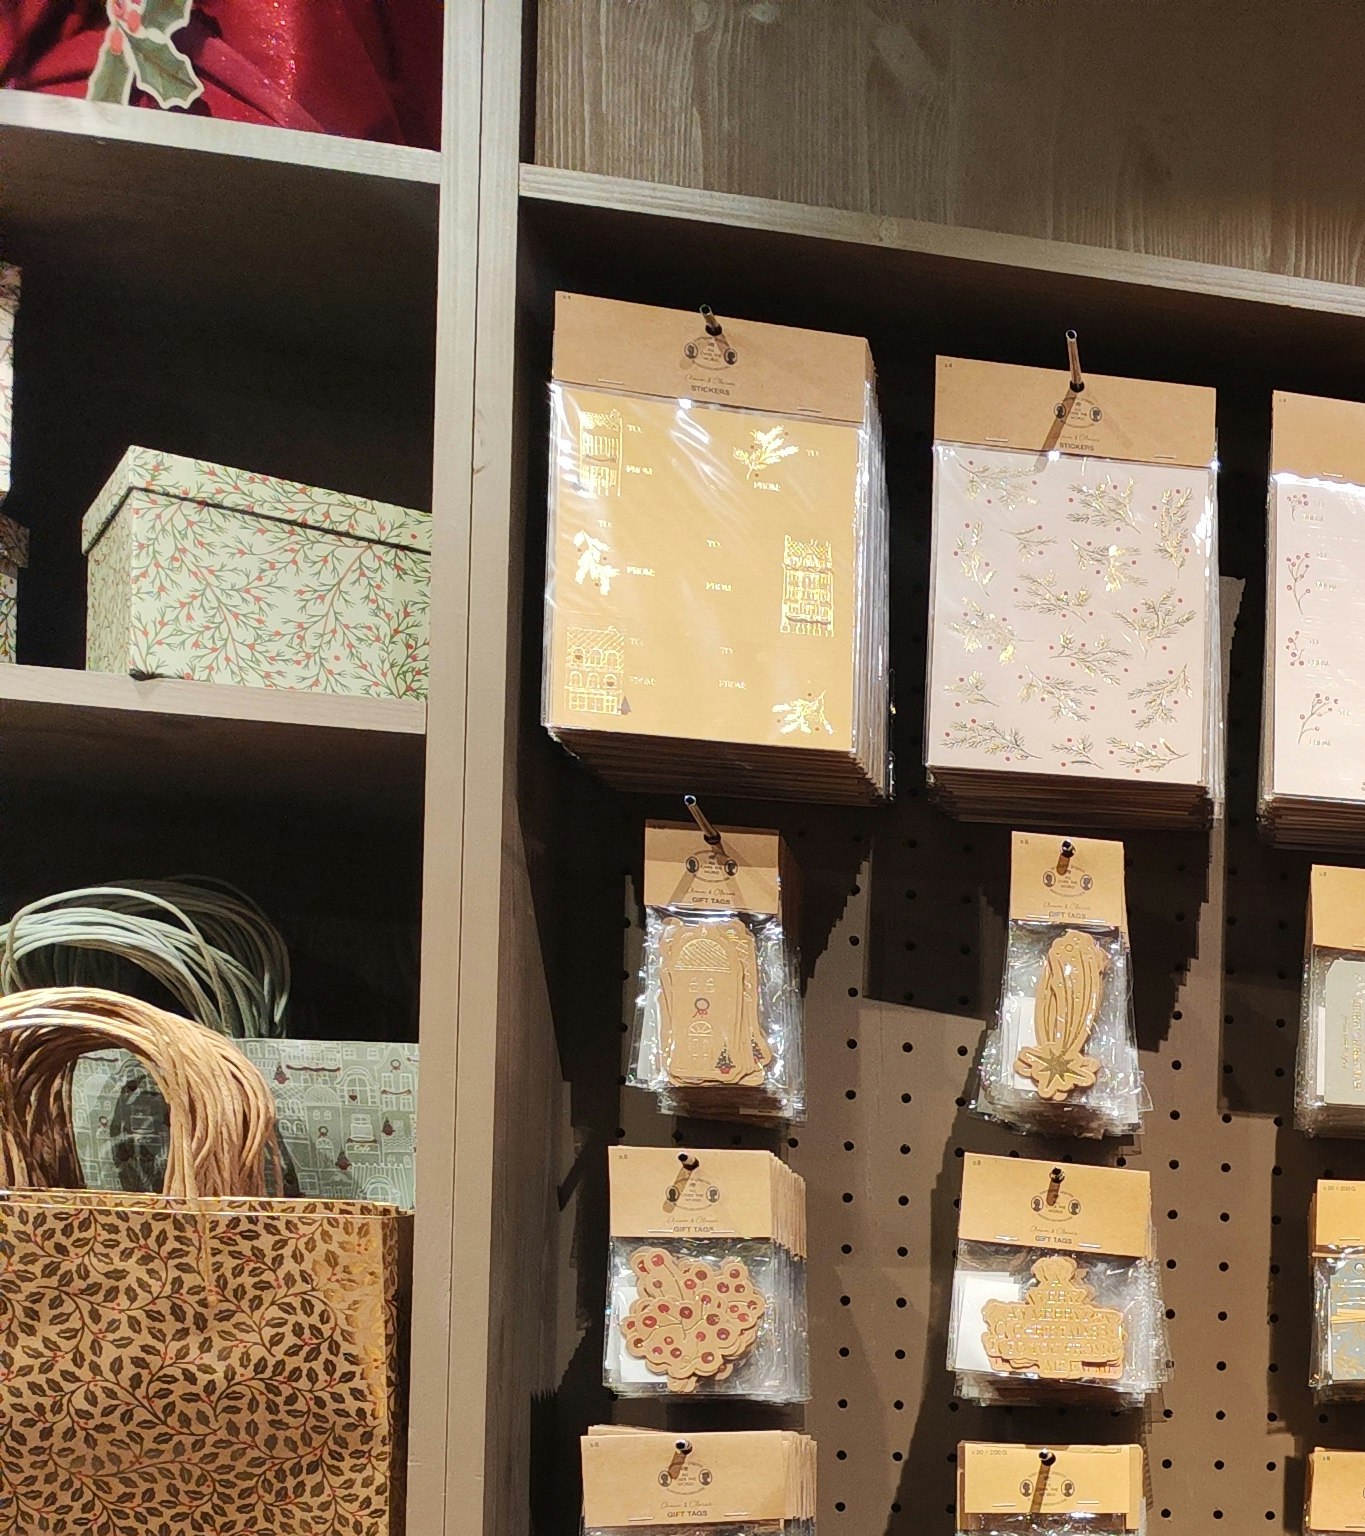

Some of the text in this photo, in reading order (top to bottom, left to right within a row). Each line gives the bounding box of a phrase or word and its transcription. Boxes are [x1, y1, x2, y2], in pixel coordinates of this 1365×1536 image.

[690, 384, 731, 396] STICKERS
[1048, 911, 1086, 919] GIFT TAGS
[1035, 1235, 1073, 1245] GIFT TAGS
